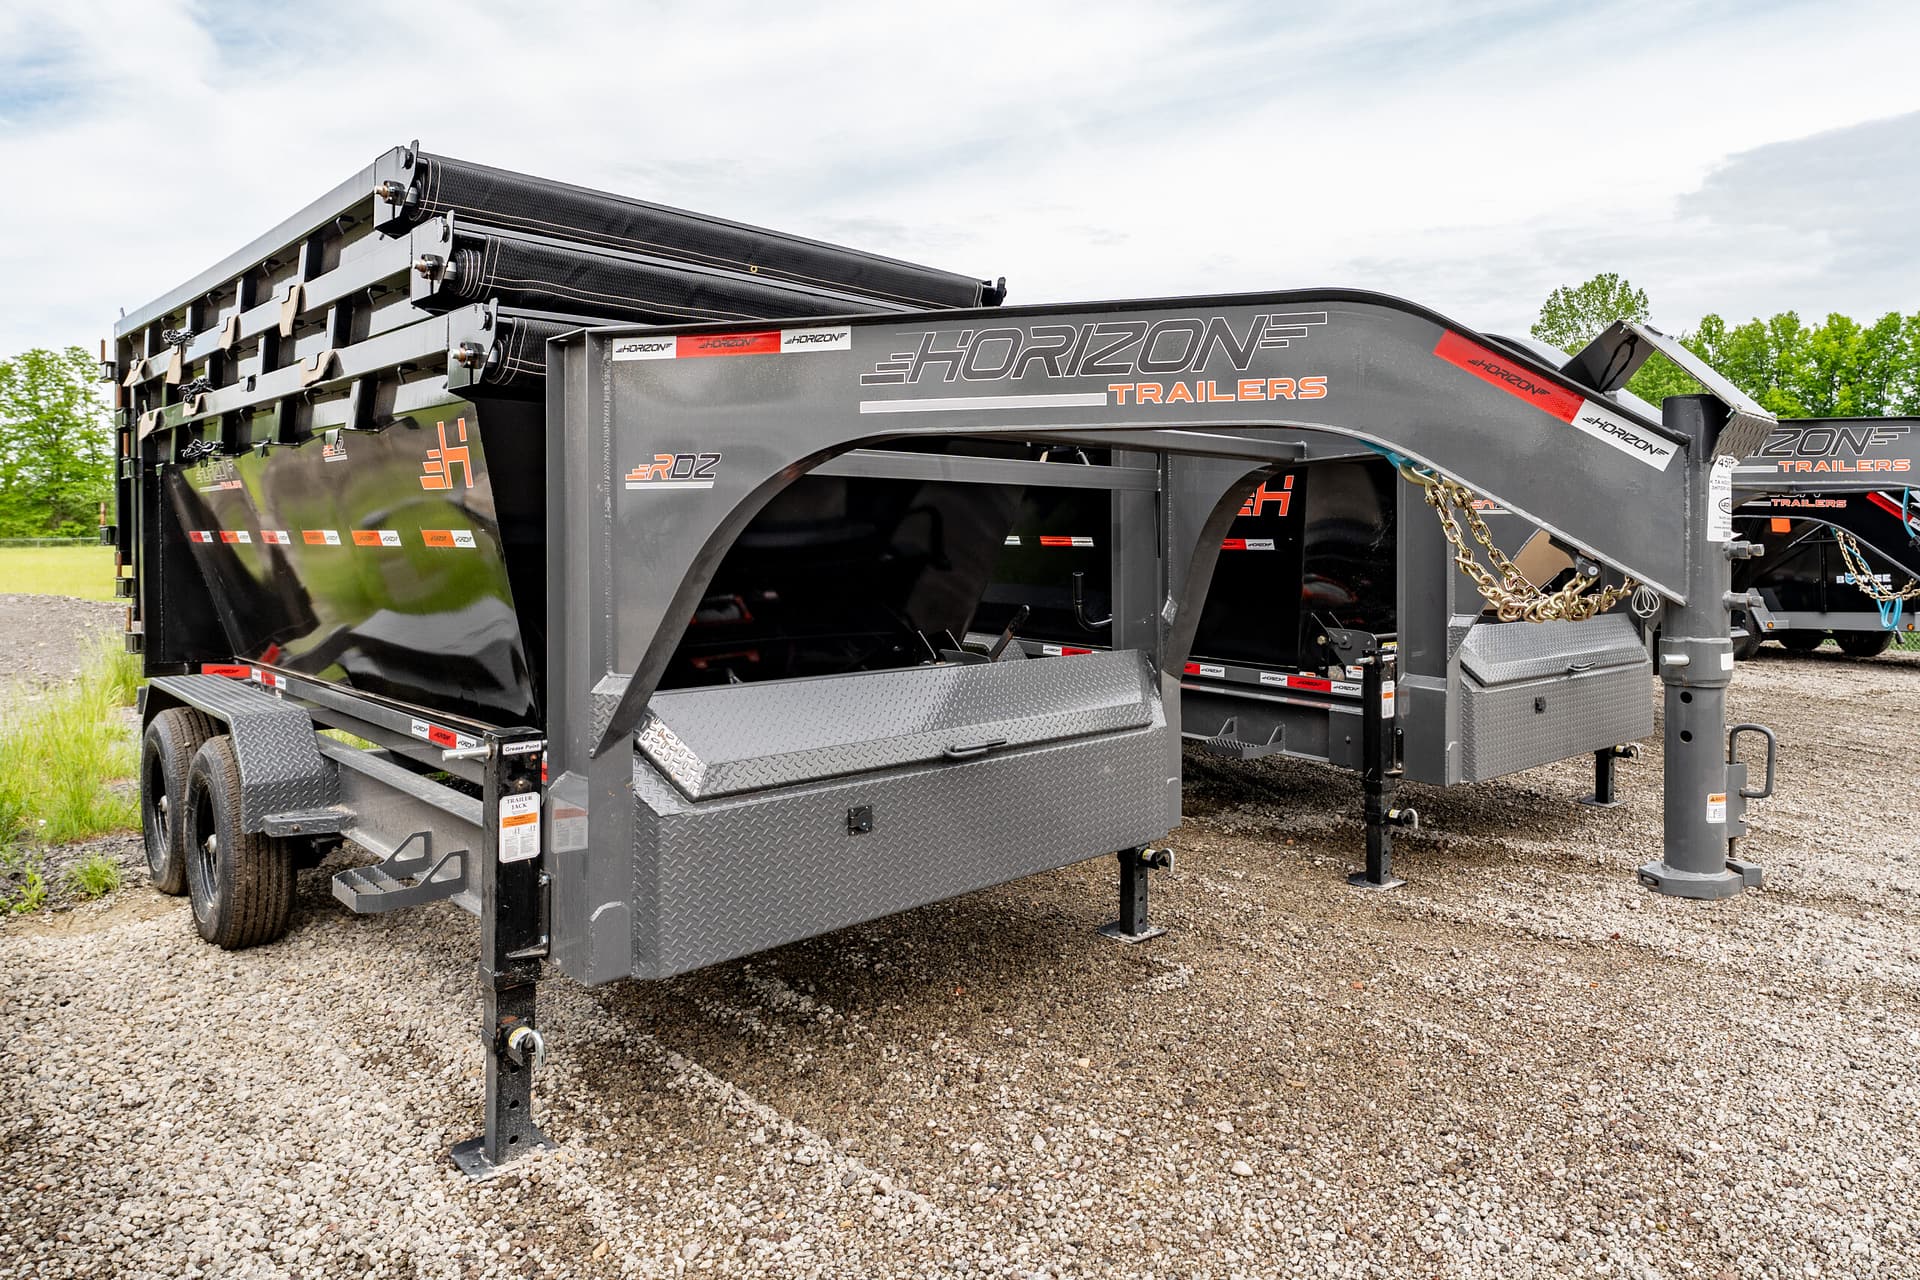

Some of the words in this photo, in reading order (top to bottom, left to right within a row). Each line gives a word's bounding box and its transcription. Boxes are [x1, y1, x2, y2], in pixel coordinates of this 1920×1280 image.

[702, 337, 755, 349] HORIZON
[790, 332, 843, 345] HORIZON
[620, 343, 669, 353] HORIZON
[900, 314, 1275, 385] HORIZON
[1475, 358, 1545, 396] HORIZON
[1108, 376, 1328, 406] TRAILERS
[1589, 417, 1661, 457] HORIZON
[1777, 459, 1911, 473] TRAILERS
[1770, 498, 1847, 508] TRAILERS
